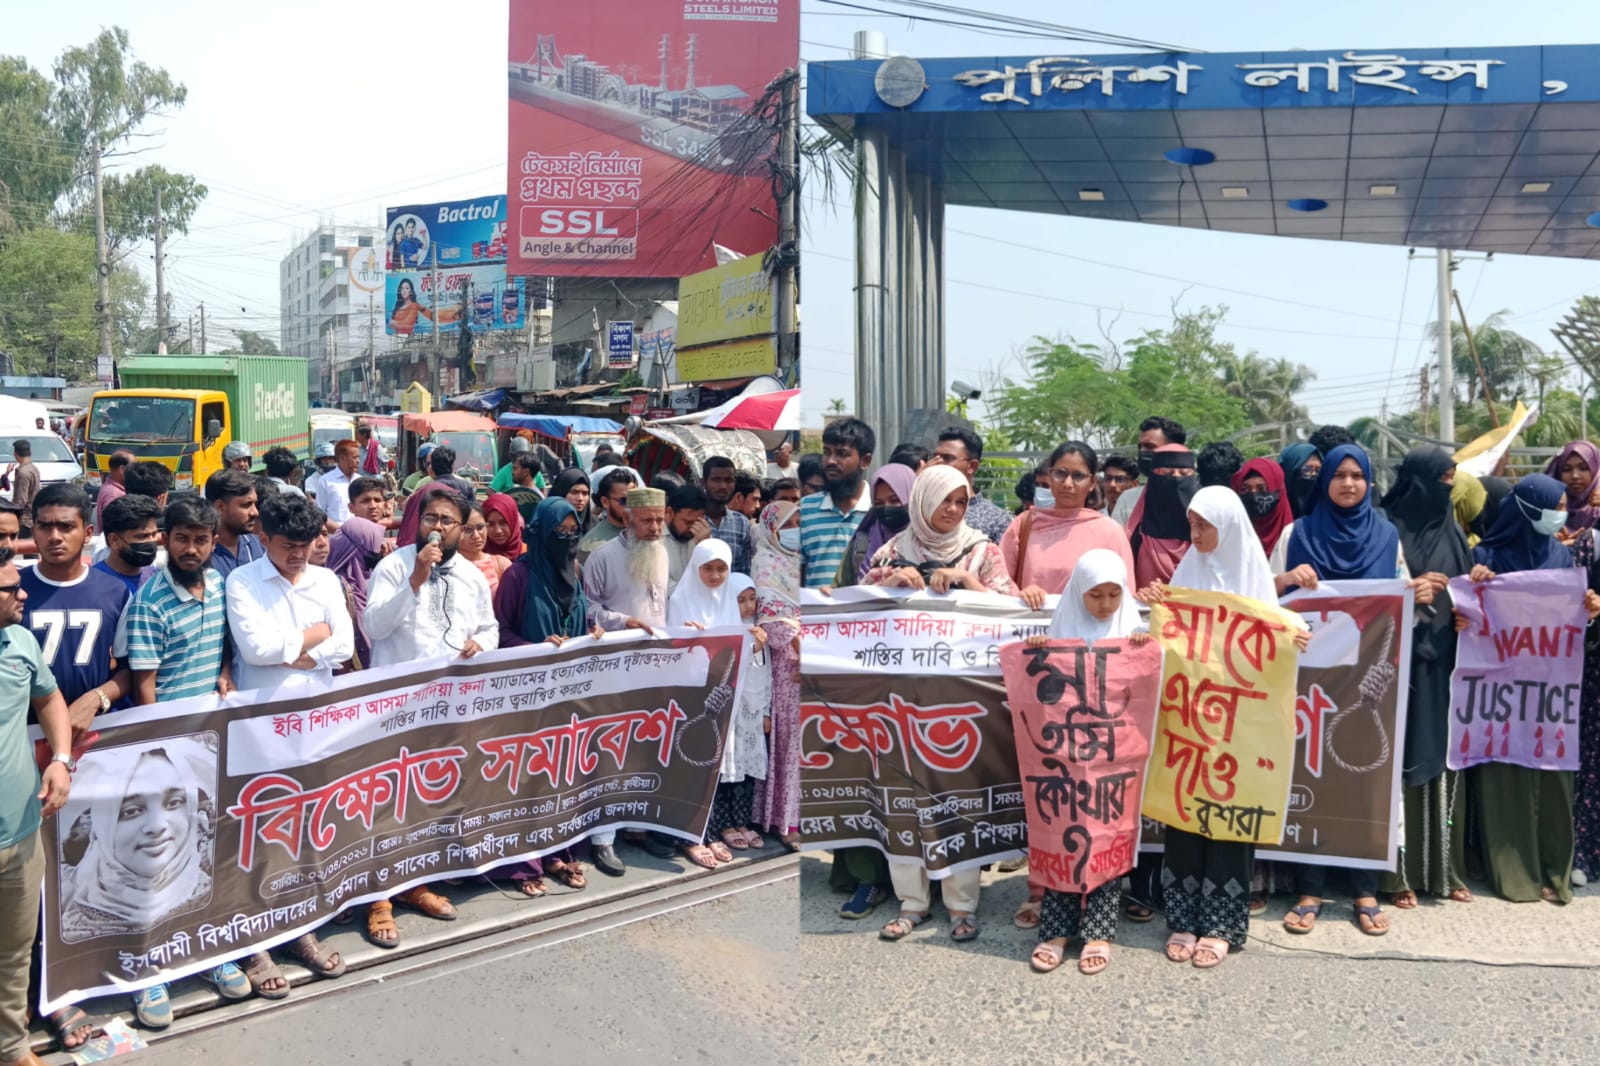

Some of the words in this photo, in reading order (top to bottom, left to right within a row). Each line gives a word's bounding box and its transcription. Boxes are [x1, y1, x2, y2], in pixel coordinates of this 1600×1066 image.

[684, 4, 730, 13] STEELS
[733, 5, 778, 15] LIMITED
[952, 56, 1204, 106] পুলিশ
[1235, 51, 1506, 96] লাইন্স
[640, 126, 672, 151] SSL
[521, 151, 582, 176] টেকসই
[583, 150, 642, 175] নির্মাণে
[520, 177, 575, 202] প্রথম
[578, 177, 642, 202] পছন্দ
[438, 200, 499, 223] Bactrol
[540, 210, 618, 235] SSL
[523, 241, 561, 256] Angle
[565, 242, 574, 254] &
[577, 241, 633, 254] Channel
[30, 609, 102, 666] 77
[836, 617, 887, 640] আসমা
[893, 612, 955, 639] সাদিয়া
[964, 619, 1003, 640] রুনা
[1473, 585, 1491, 638] I
[1493, 623, 1583, 663] WANT
[853, 641, 904, 667] শাস্তির
[910, 641, 953, 667] দাবি
[961, 650, 977, 666] ও
[272, 714, 301, 738] ইবি
[309, 703, 360, 732] শিক্ষিকা
[365, 692, 410, 715] আসমা
[412, 681, 453, 702] সাদিয়া
[458, 678, 486, 696] রুনা
[490, 669, 547, 690] ম্যাডামের
[550, 656, 620, 681] হত্যাকারীদের
[624, 651, 683, 672] দৃষ্টান্তমূলক
[1022, 646, 1121, 715] মা
[379, 711, 416, 732] শাস্তির
[420, 699, 449, 721] দাবি
[455, 704, 468, 717] ও
[471, 698, 504, 716] বিচার
[559, 680, 593, 697] করতে
[1160, 672, 1269, 746] এনে
[1455, 675, 1580, 725] JUSTICE
[225, 745, 468, 872] বিক্ষোভ
[476, 698, 688, 796] সমাবেশ
[487, 807, 512, 822] সকাল
[897, 829, 915, 847] ও
[119, 932, 193, 977] ইসলামী
[197, 895, 319, 951] বিশ্ববিদ্যালয়ের
[324, 871, 371, 906] বর্তমান
[375, 867, 390, 882] ও
[393, 850, 441, 876] সাবেক
[446, 832, 521, 864] শিক্ষার্থীবৃন্দ
[526, 827, 554, 844] এবং
[604, 800, 649, 817] জনগণ
